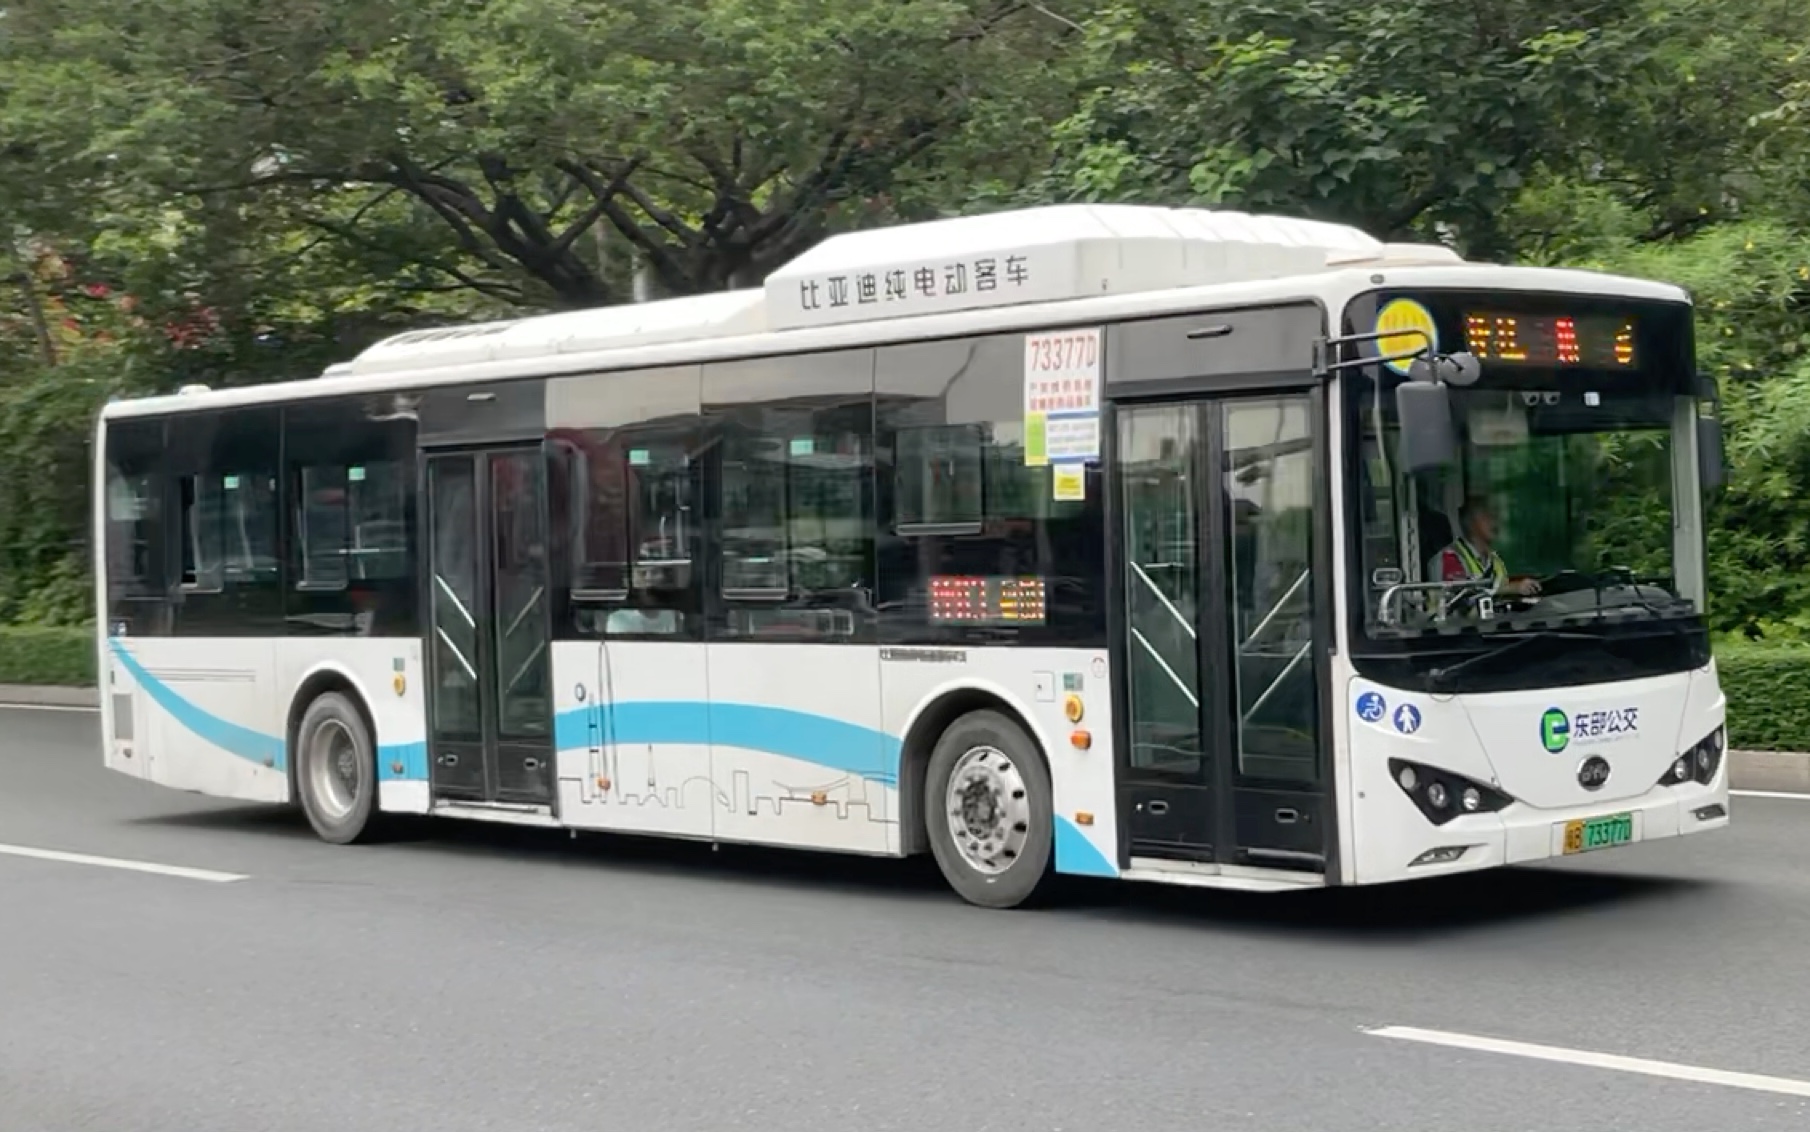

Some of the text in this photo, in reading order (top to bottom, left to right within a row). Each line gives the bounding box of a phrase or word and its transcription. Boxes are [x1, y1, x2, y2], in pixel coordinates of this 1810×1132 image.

[800, 255, 1029, 310] 比亚迪纯电动客车
[1574, 707, 1638, 737] 东部公交
